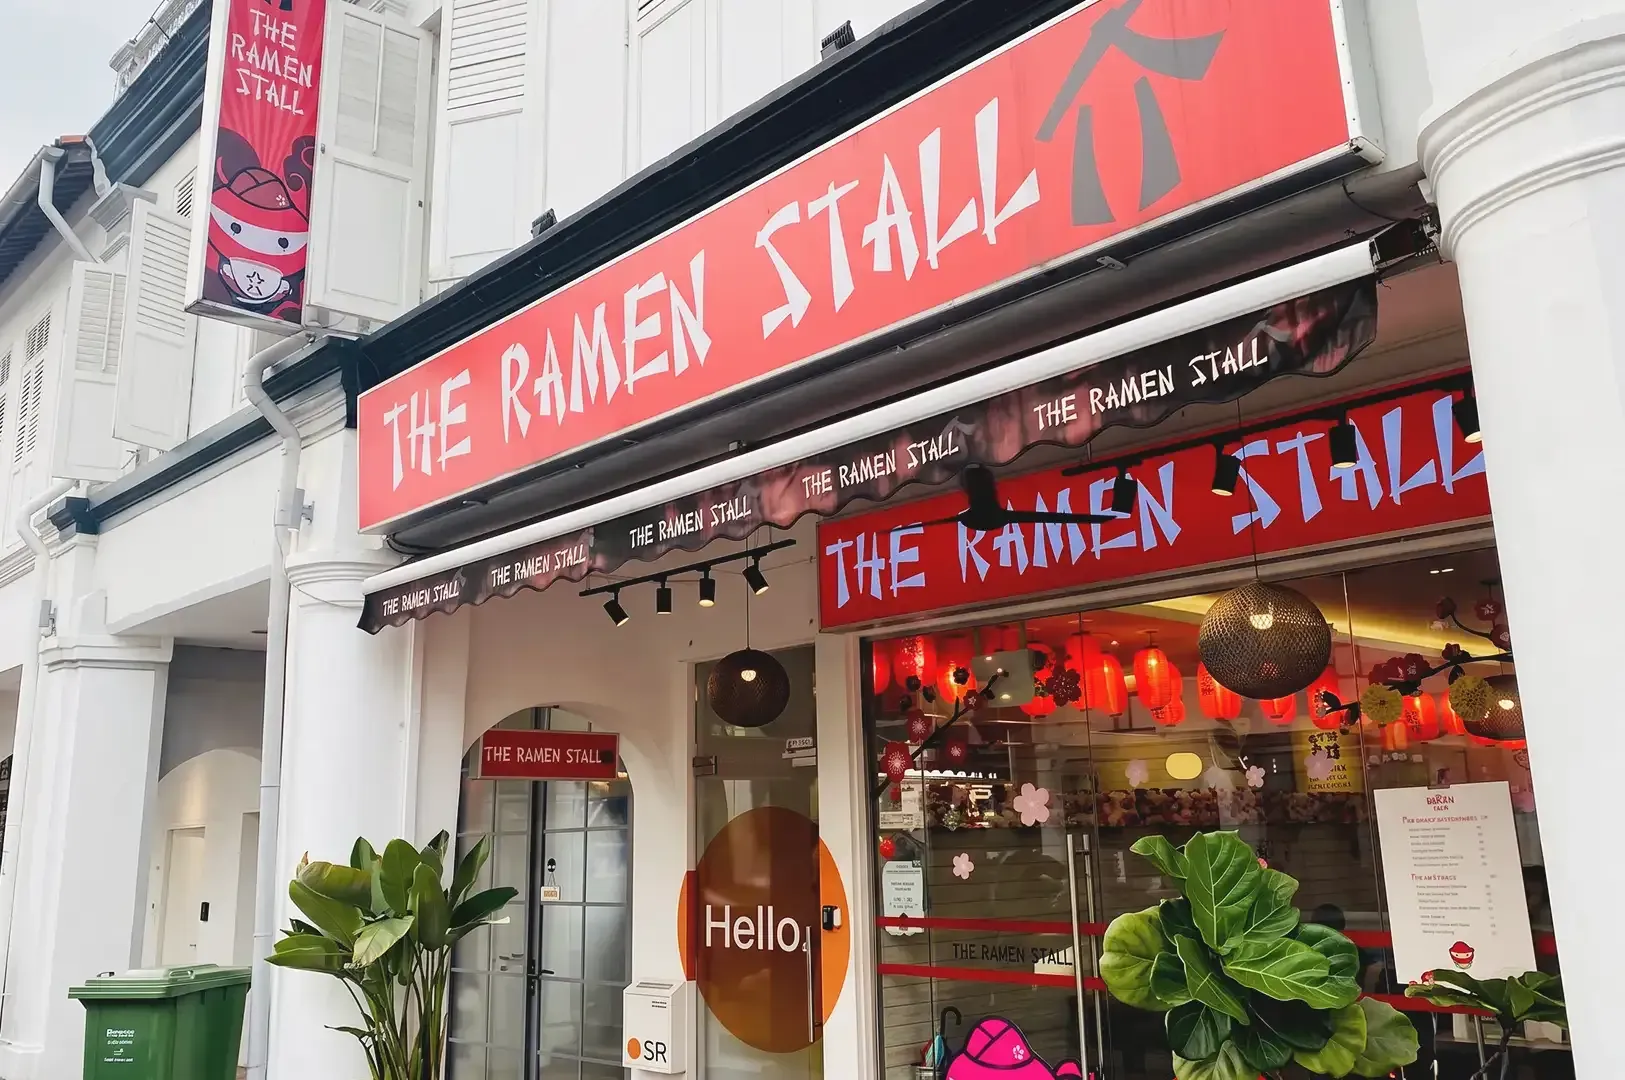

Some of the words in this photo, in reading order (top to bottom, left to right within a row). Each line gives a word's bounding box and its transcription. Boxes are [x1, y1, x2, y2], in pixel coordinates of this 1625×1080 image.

[250, 8, 297, 51] THE
[232, 33, 312, 88] RAMEN
[236, 68, 304, 115] STALL
[383, 368, 471, 492] THE
[501, 249, 712, 444] RAMEN
[754, 97, 1040, 340] STALL
[1034, 394, 1077, 430] THE
[1090, 366, 1174, 414] RAMEN
[1189, 338, 1267, 386] STALL
[802, 470, 832, 498] THE
[839, 450, 896, 487] RAMEN
[907, 432, 958, 469] STALL
[630, 524, 653, 548] THE
[659, 509, 703, 541] RAMEN
[710, 496, 751, 527] STALL
[826, 526, 925, 609] THE
[957, 461, 1182, 583] RAMEN
[1232, 395, 1486, 535] STALL
[492, 565, 510, 587] THE
[515, 554, 549, 581] RAMEN
[554, 544, 586, 570] STALL
[383, 598, 398, 616] THE
[402, 588, 430, 611] RAMEN
[433, 580, 459, 602] STALL
[484, 747, 511, 761] THE
[517, 748, 560, 762] RAMEN
[567, 749, 601, 763] STALL
[952, 943, 977, 960] THE
[981, 945, 1025, 963] RAMEN
[1031, 948, 1073, 966] STALL
[643, 1040, 667, 1065] SR
